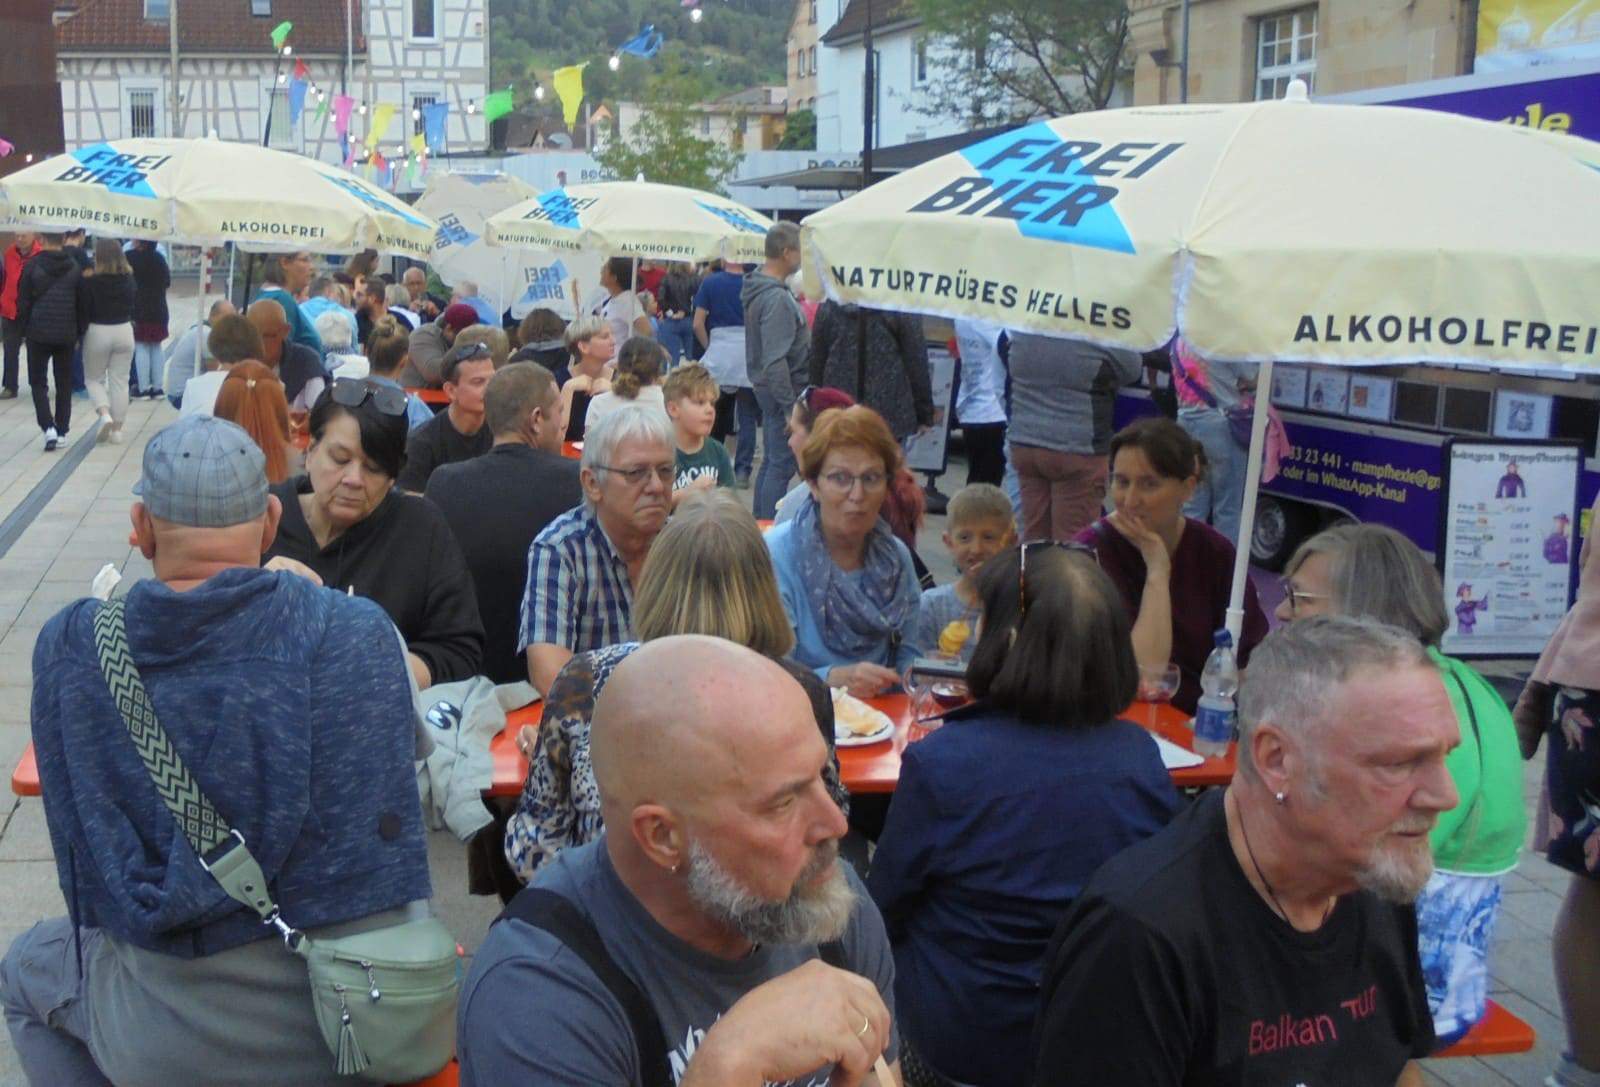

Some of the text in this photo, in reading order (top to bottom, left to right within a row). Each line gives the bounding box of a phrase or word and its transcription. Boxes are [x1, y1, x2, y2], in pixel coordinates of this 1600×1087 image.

[81, 149, 173, 171] FREI
[979, 138, 1186, 179] FREI
[54, 165, 149, 189] BIER
[541, 195, 600, 210] FREI
[906, 176, 1119, 227] BIER
[19, 204, 110, 222] NATURTRÜBES
[113, 214, 158, 230] HELLES
[521, 207, 580, 223] BIER
[220, 220, 325, 238] ALKOHOLFREI
[620, 242, 695, 256] ALKOHOLFREI
[831, 264, 1132, 330] NATURTRÜBES HELLES
[1293, 315, 1597, 355] ALKOHOLFREI
[1304, 449, 1318, 465] 23
[1322, 452, 1341, 469] 441
[1283, 465, 1407, 503] oder im WhatsApp-Kanal
[1249, 1013, 1339, 1056] Balkan
